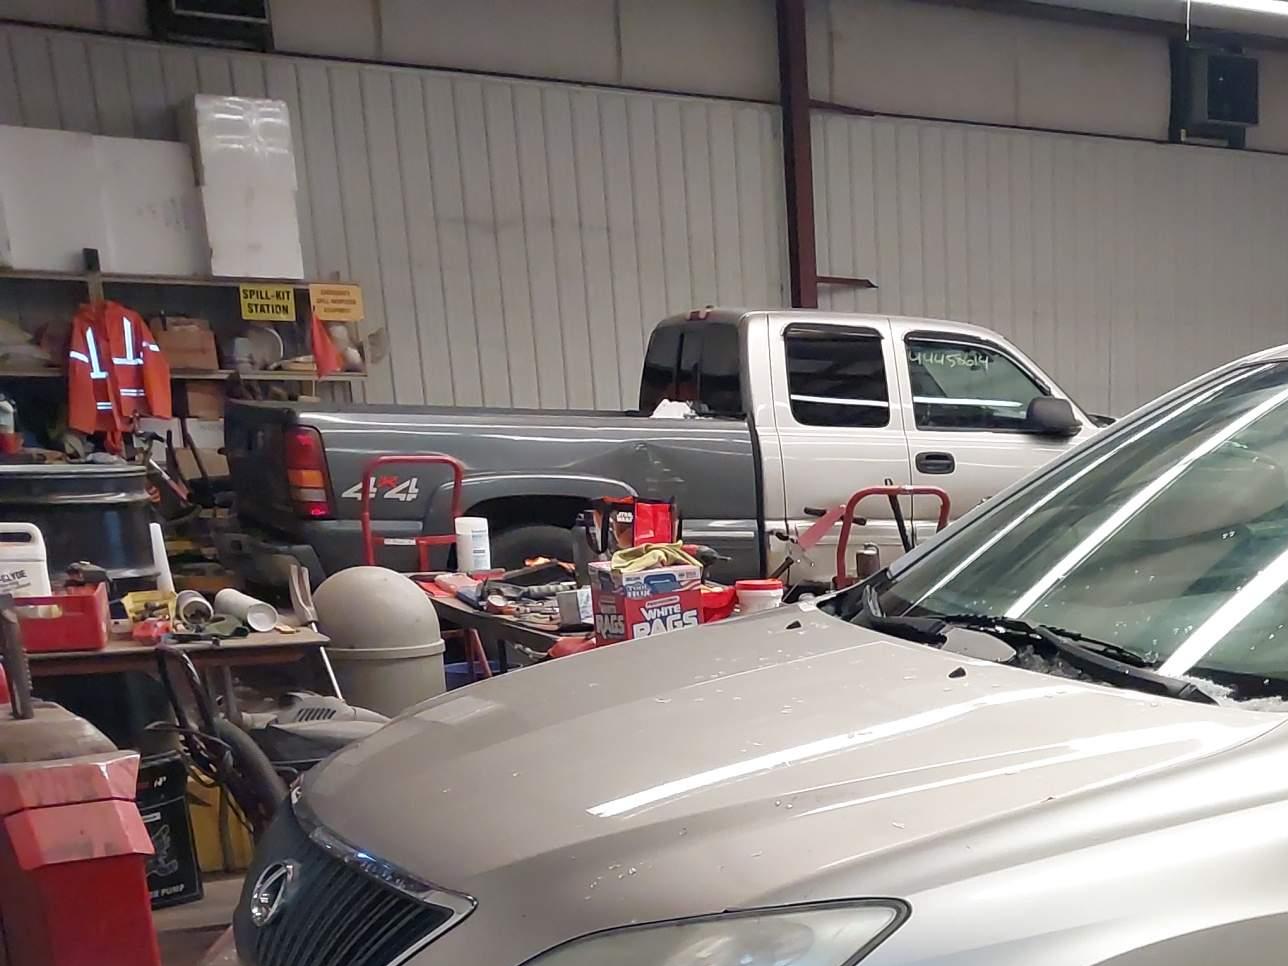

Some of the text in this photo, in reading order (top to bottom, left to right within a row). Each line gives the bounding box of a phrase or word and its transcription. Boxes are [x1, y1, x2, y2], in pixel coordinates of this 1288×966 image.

[242, 288, 291, 301] SPILL-KIT
[247, 302, 289, 315] STATION
[640, 603, 681, 621] WHITE
[596, 614, 625, 639] RAGS
[633, 609, 699, 640] RAGS
[161, 883, 185, 897] PUMP
